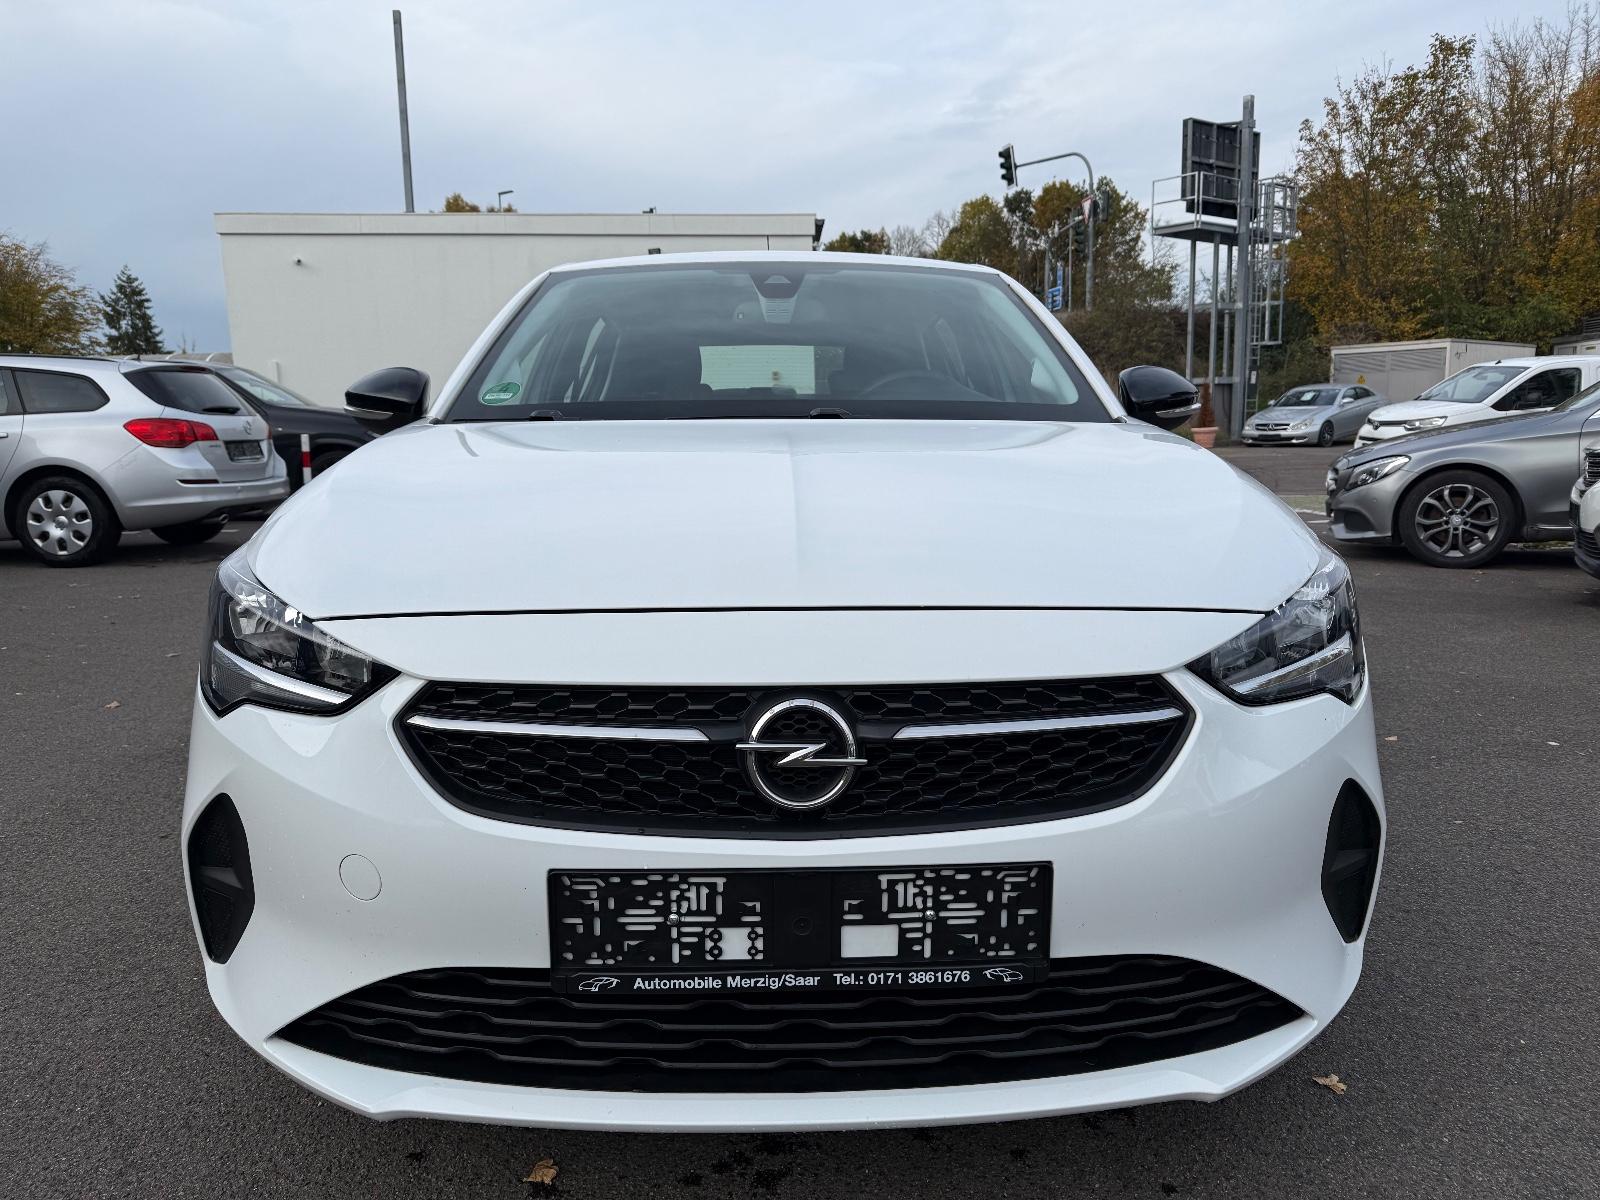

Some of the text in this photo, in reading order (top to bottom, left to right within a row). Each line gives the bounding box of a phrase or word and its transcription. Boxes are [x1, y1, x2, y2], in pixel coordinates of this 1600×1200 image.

[633, 970, 971, 990] Automobile Merzig/Saar Tel.: 0171 3861676
